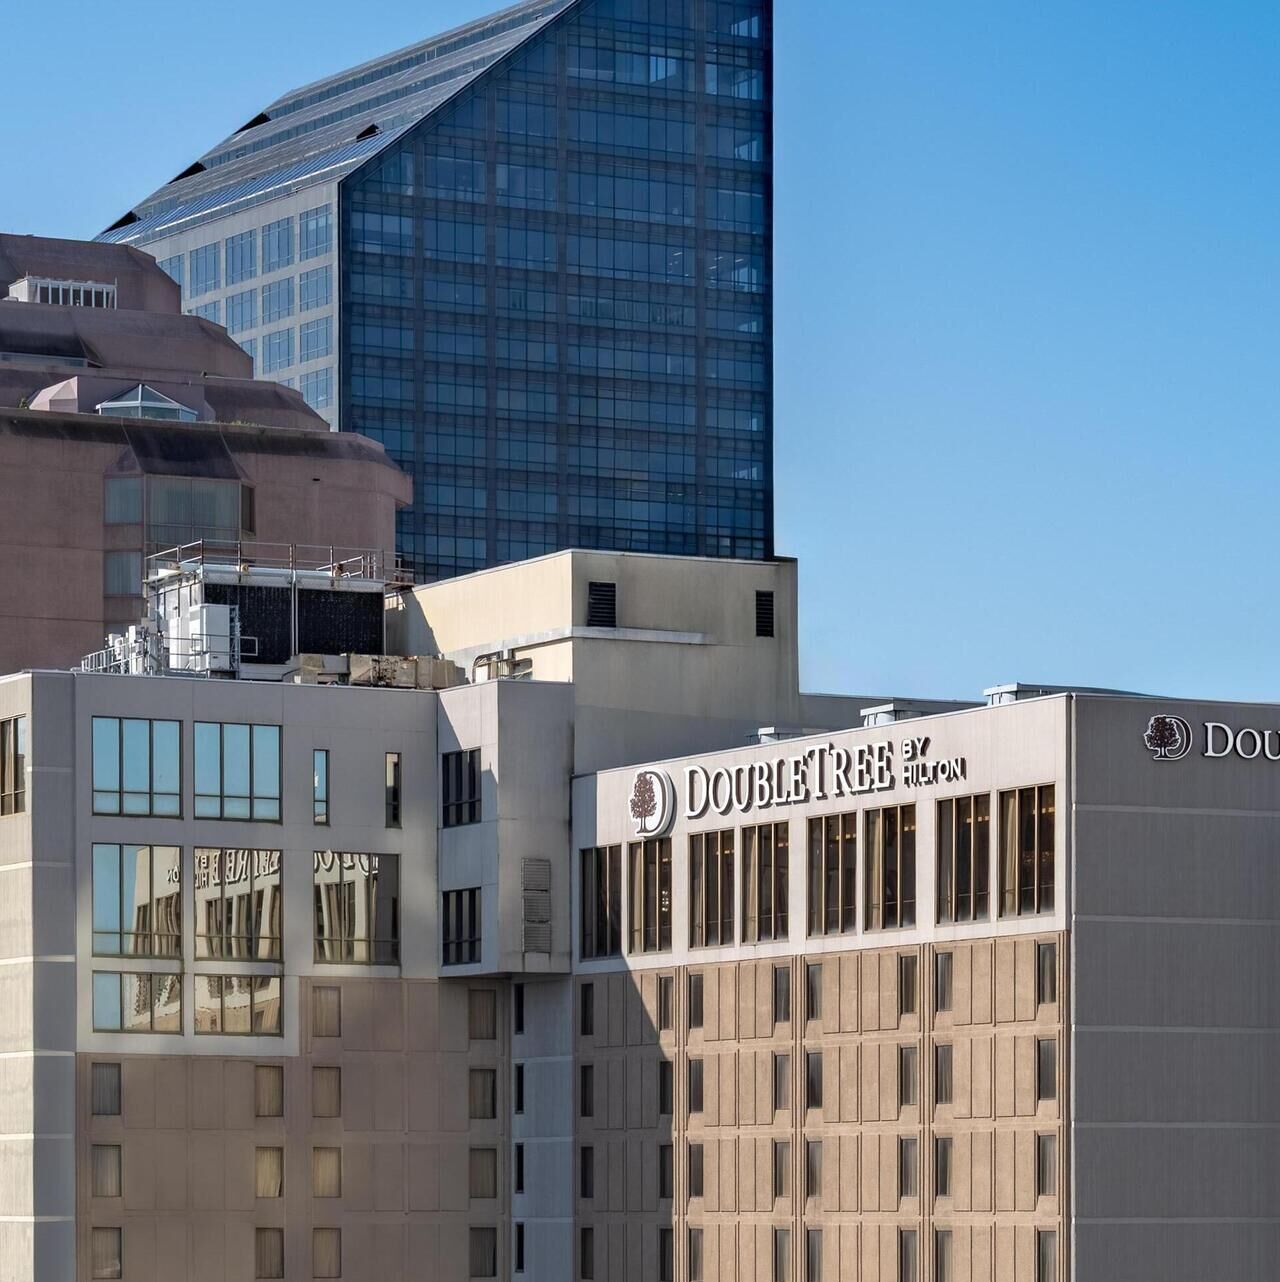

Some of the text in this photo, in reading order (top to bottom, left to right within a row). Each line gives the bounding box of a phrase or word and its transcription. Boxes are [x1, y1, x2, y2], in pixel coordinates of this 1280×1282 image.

[900, 736, 930, 759] BY
[683, 741, 894, 818] DOUBLETREE
[902, 757, 966, 786] HILTON
